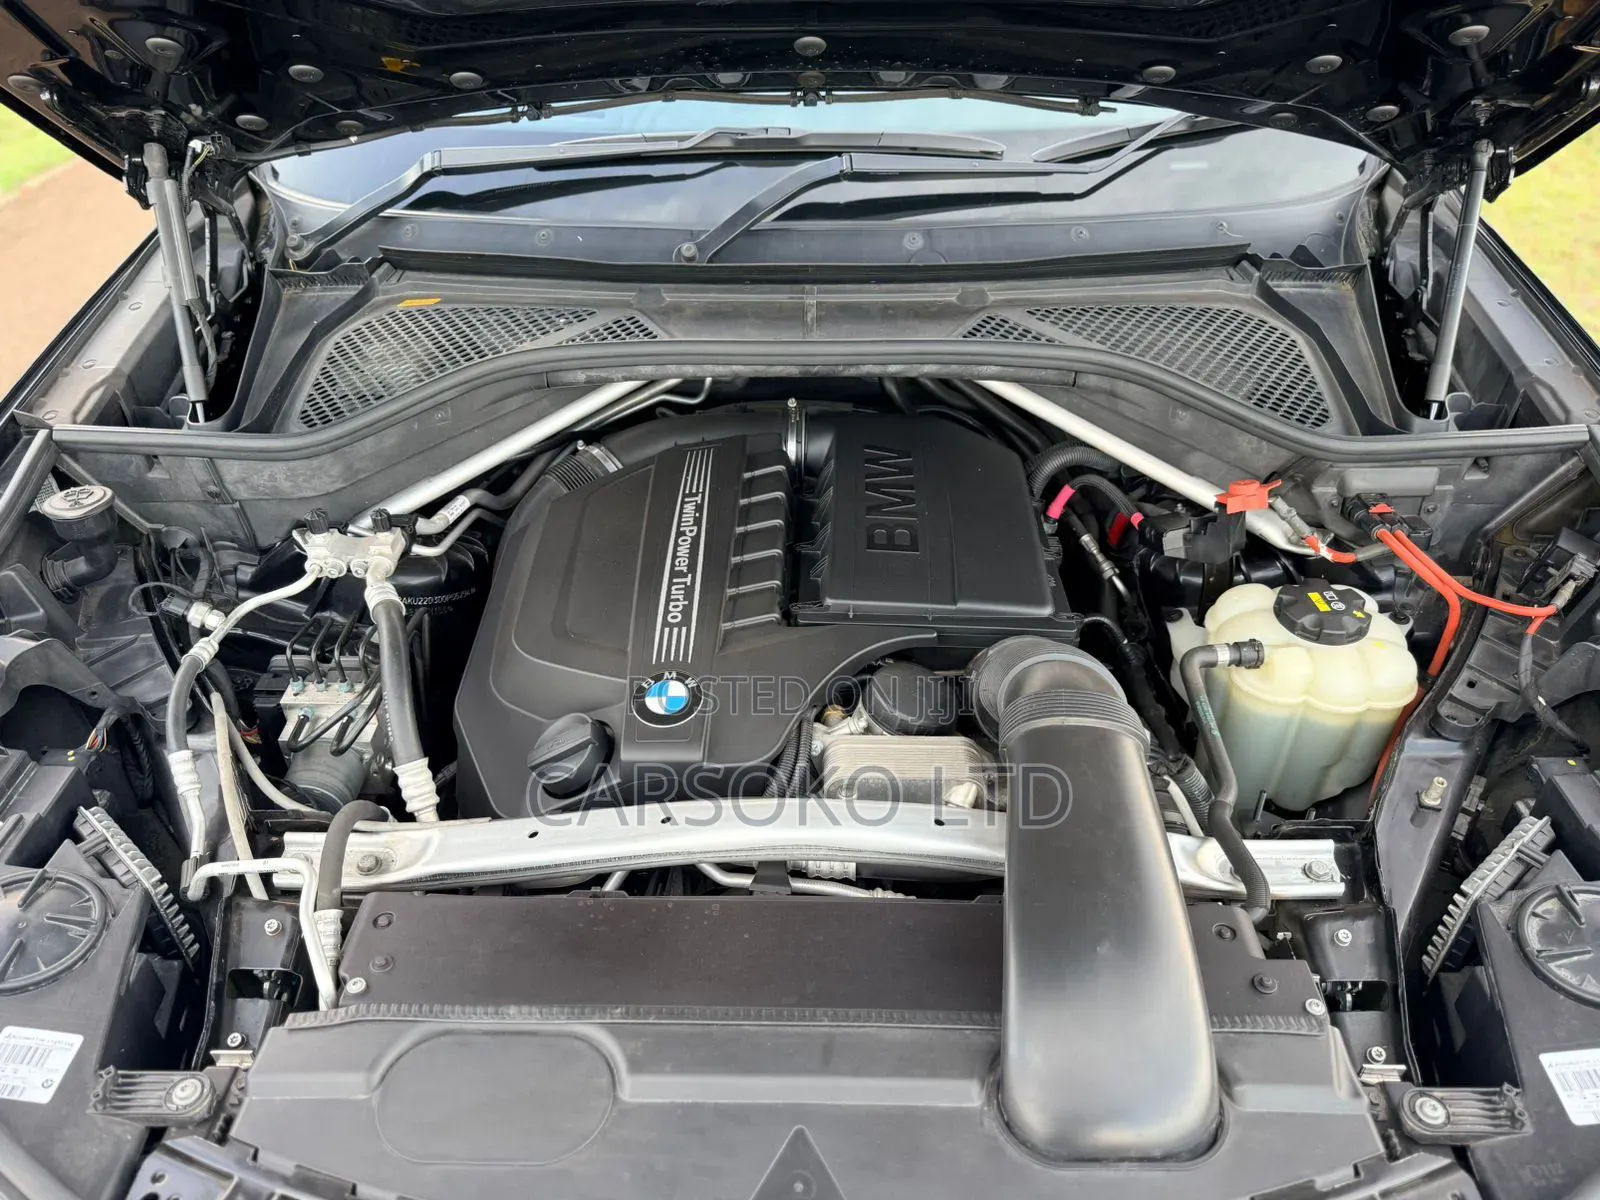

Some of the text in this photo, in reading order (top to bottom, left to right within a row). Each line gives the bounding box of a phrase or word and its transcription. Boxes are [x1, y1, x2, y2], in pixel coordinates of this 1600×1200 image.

[666, 493, 702, 623] TwinPower Turbo
[863, 447, 920, 554] BMW
